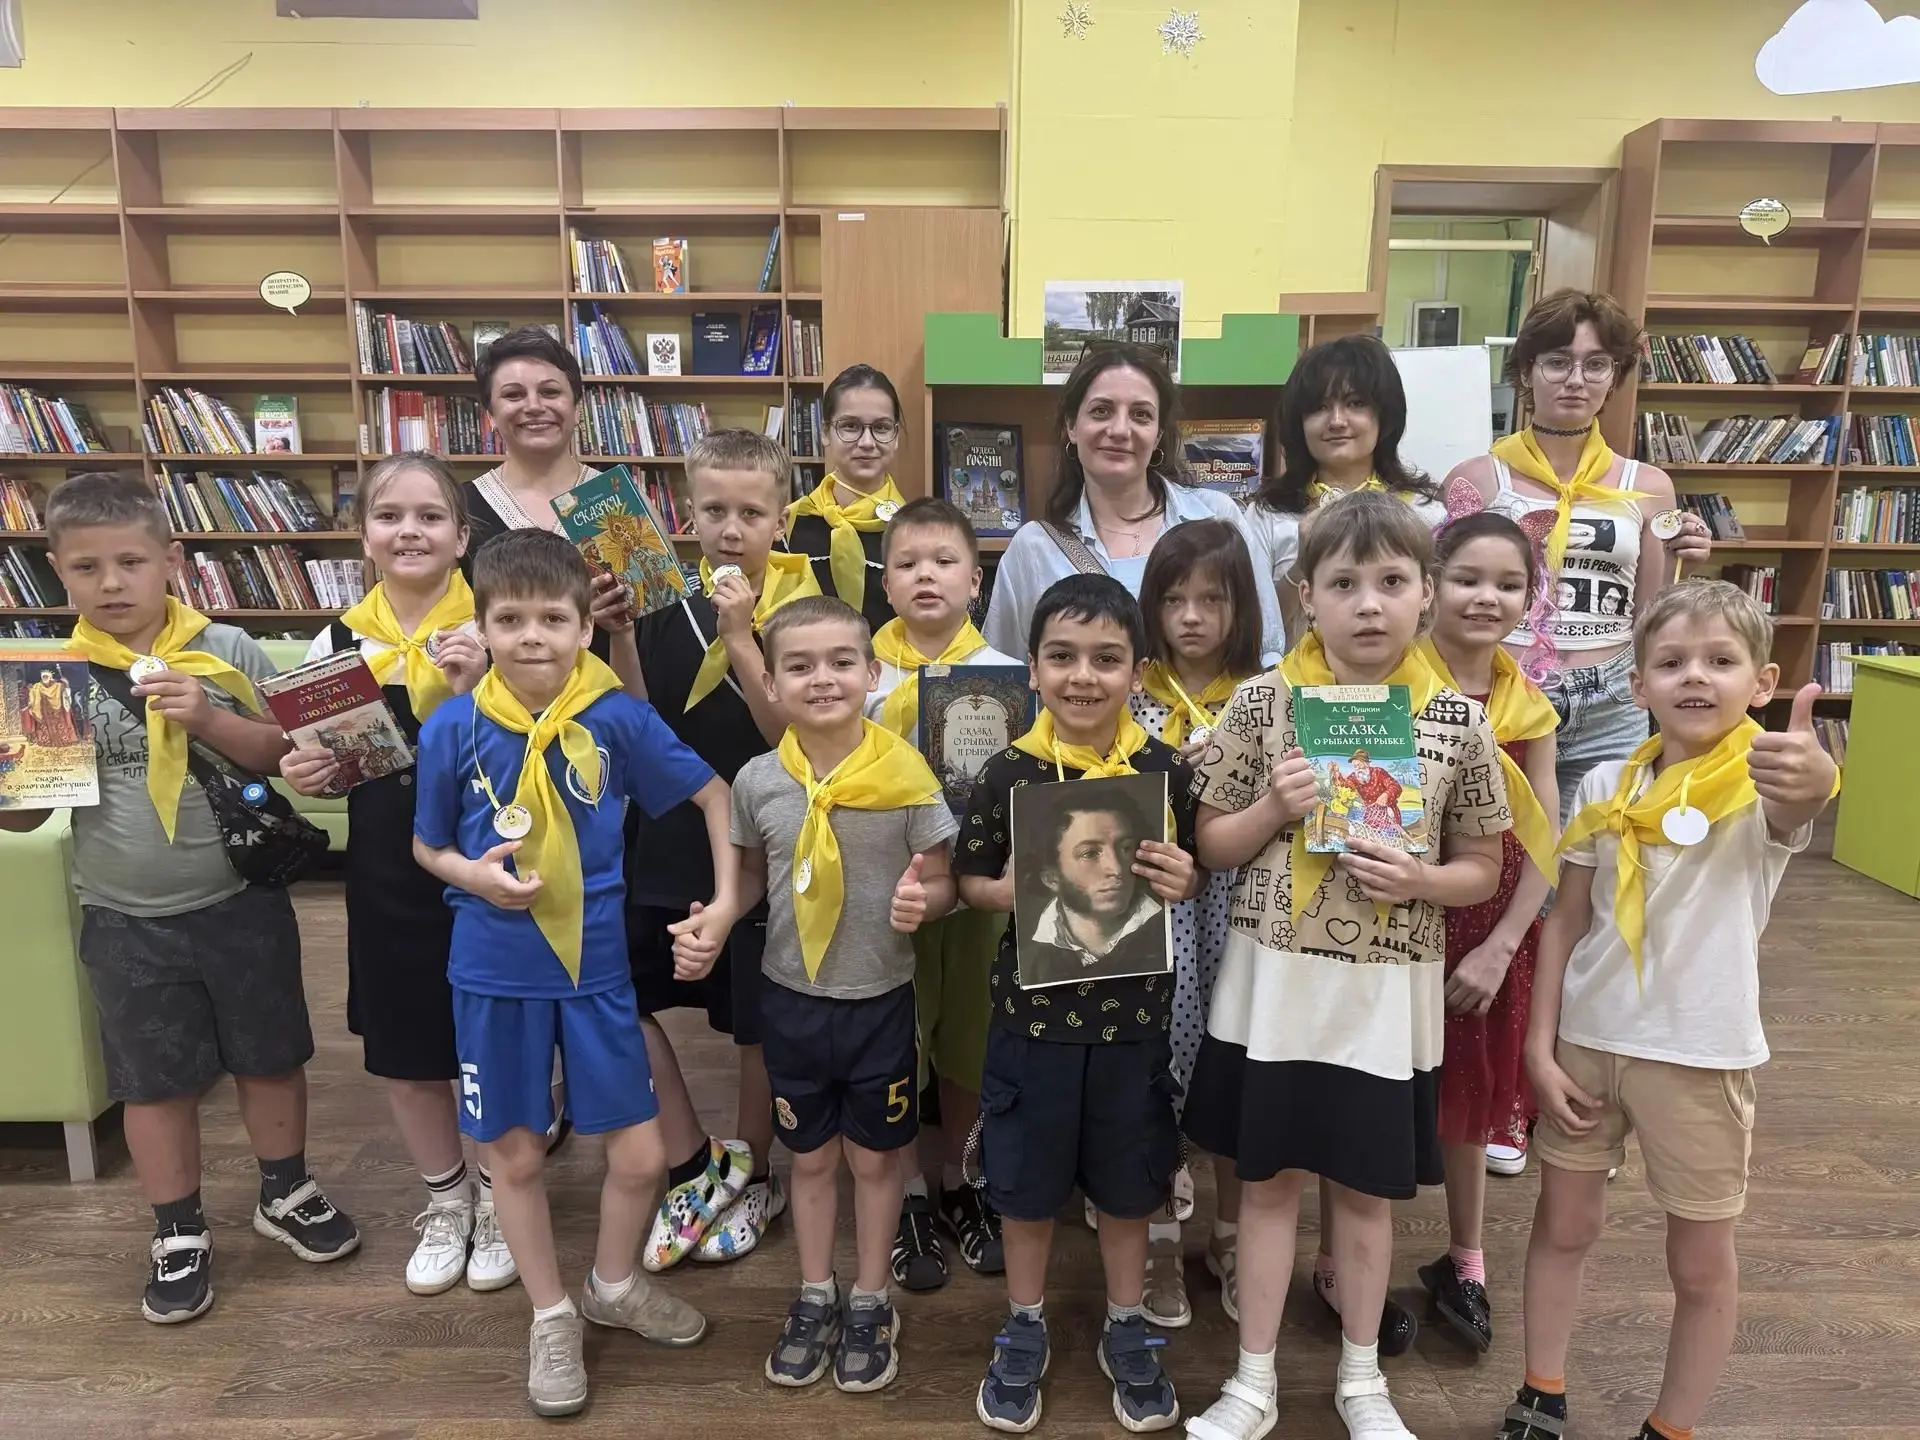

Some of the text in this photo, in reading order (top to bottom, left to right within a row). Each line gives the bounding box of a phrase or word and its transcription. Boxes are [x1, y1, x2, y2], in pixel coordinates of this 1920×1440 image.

[1047, 353, 1080, 363] НАША
[971, 446, 996, 455] ЧУДЕСА
[966, 454, 1002, 467] РОССИИ
[1213, 459, 1251, 472] Родина
[1196, 470, 1242, 483] Россия
[573, 494, 623, 527] СКАЗКИ
[1562, 557, 1575, 569] TO
[1578, 558, 1590, 570] 15
[298, 682, 350, 705] РУСЛАН
[299, 694, 365, 722] ЛЮДМИЛА
[1350, 706, 1381, 714] Пушкин
[1431, 700, 1467, 714] ELLO
[959, 727, 993, 737] СКАЗКА
[1329, 724, 1388, 736] СКАЗКА
[953, 737, 1000, 747] О РЫБАКЕ
[1313, 737, 1406, 746] О РЫБАКЕ И РЫБКЕ
[106, 751, 149, 767] CREATE
[460, 1063, 482, 1120] 5
[886, 1076, 910, 1123] 5
